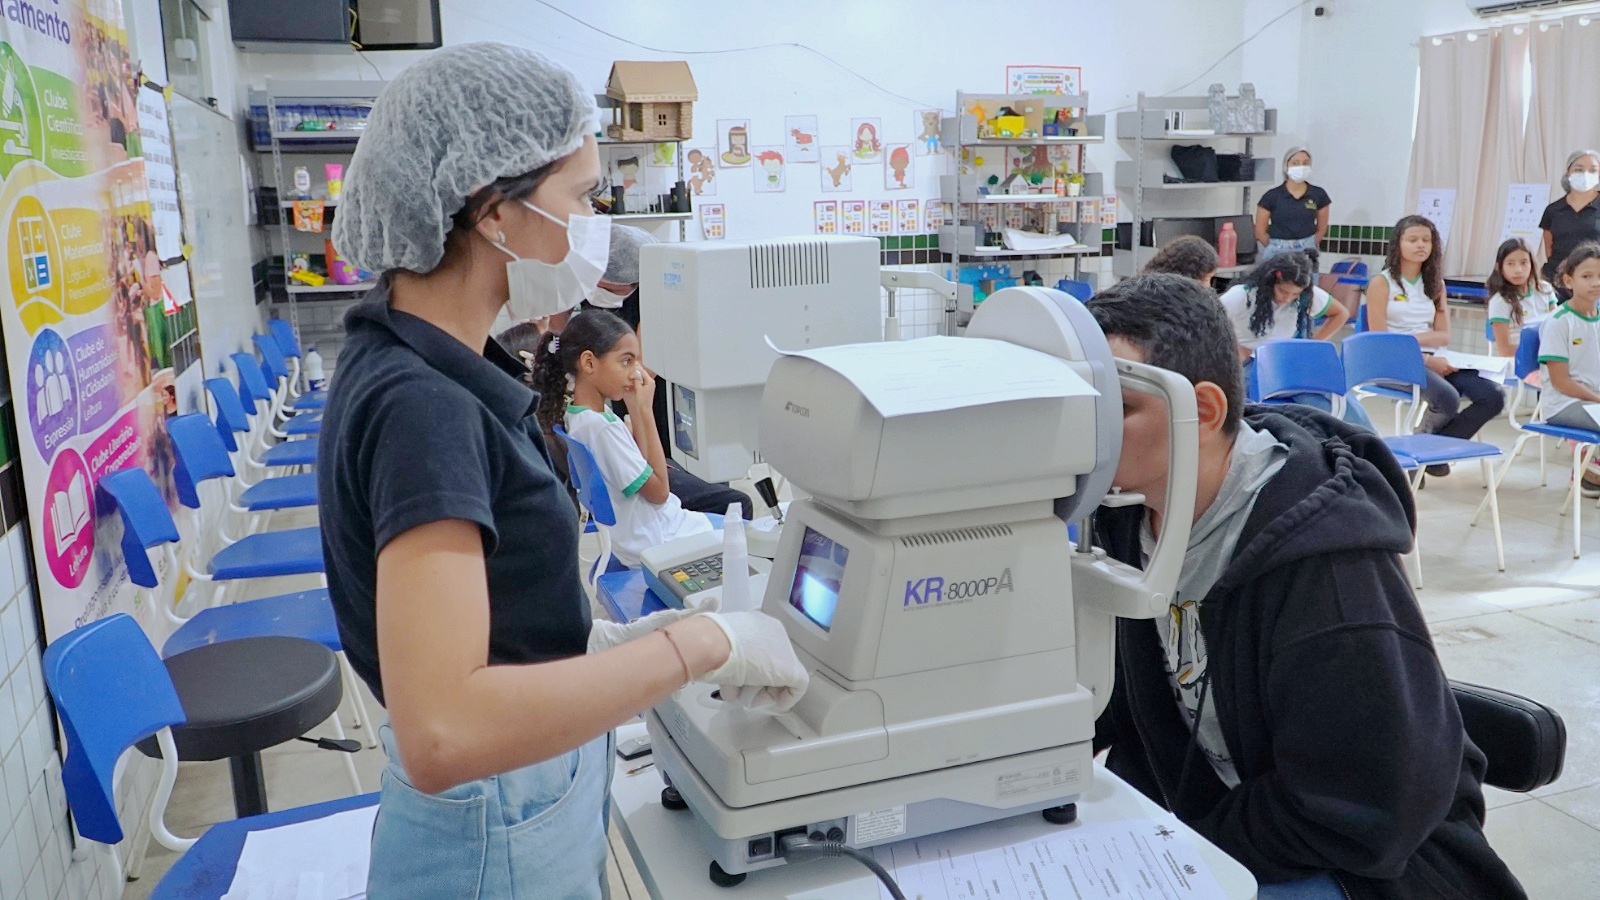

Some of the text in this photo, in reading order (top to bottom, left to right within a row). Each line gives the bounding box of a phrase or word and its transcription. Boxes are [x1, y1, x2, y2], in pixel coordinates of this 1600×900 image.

[43, 88, 68, 111] Clube
[61, 223, 83, 240] Clube
[76, 339, 105, 362] Clube de
[83, 400, 103, 421] Leitura
[92, 448, 111, 473] Clube
[68, 545, 89, 577] Leitura
